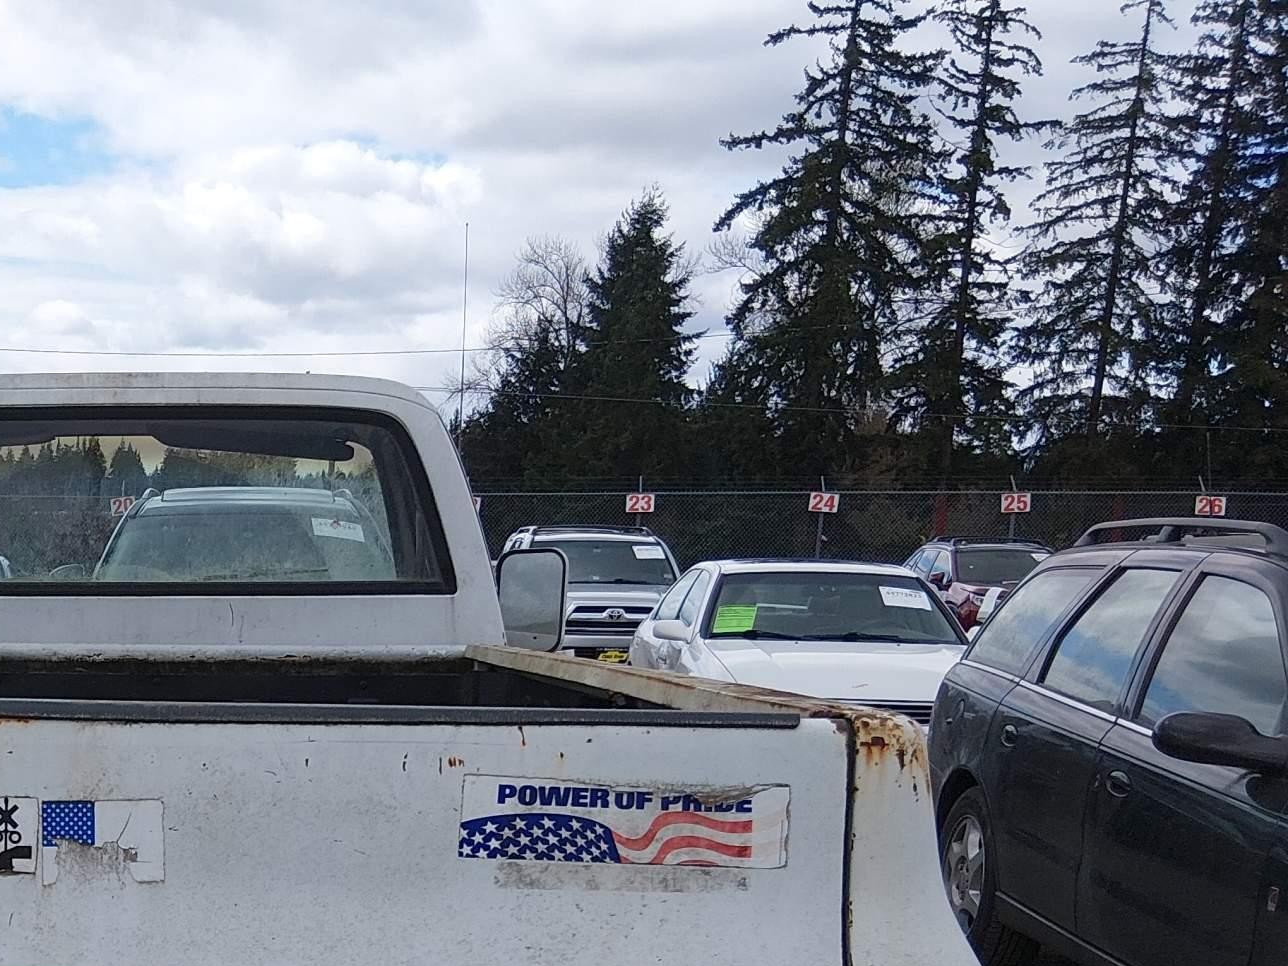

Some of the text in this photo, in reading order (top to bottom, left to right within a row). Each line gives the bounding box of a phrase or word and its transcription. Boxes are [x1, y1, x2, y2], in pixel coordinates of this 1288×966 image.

[113, 497, 134, 515] 20
[628, 495, 652, 511] 23
[811, 494, 835, 511] 24
[1003, 494, 1028, 511] 25
[1198, 497, 1223, 515] 26
[497, 784, 610, 808] POWER
[615, 791, 653, 810] OF
